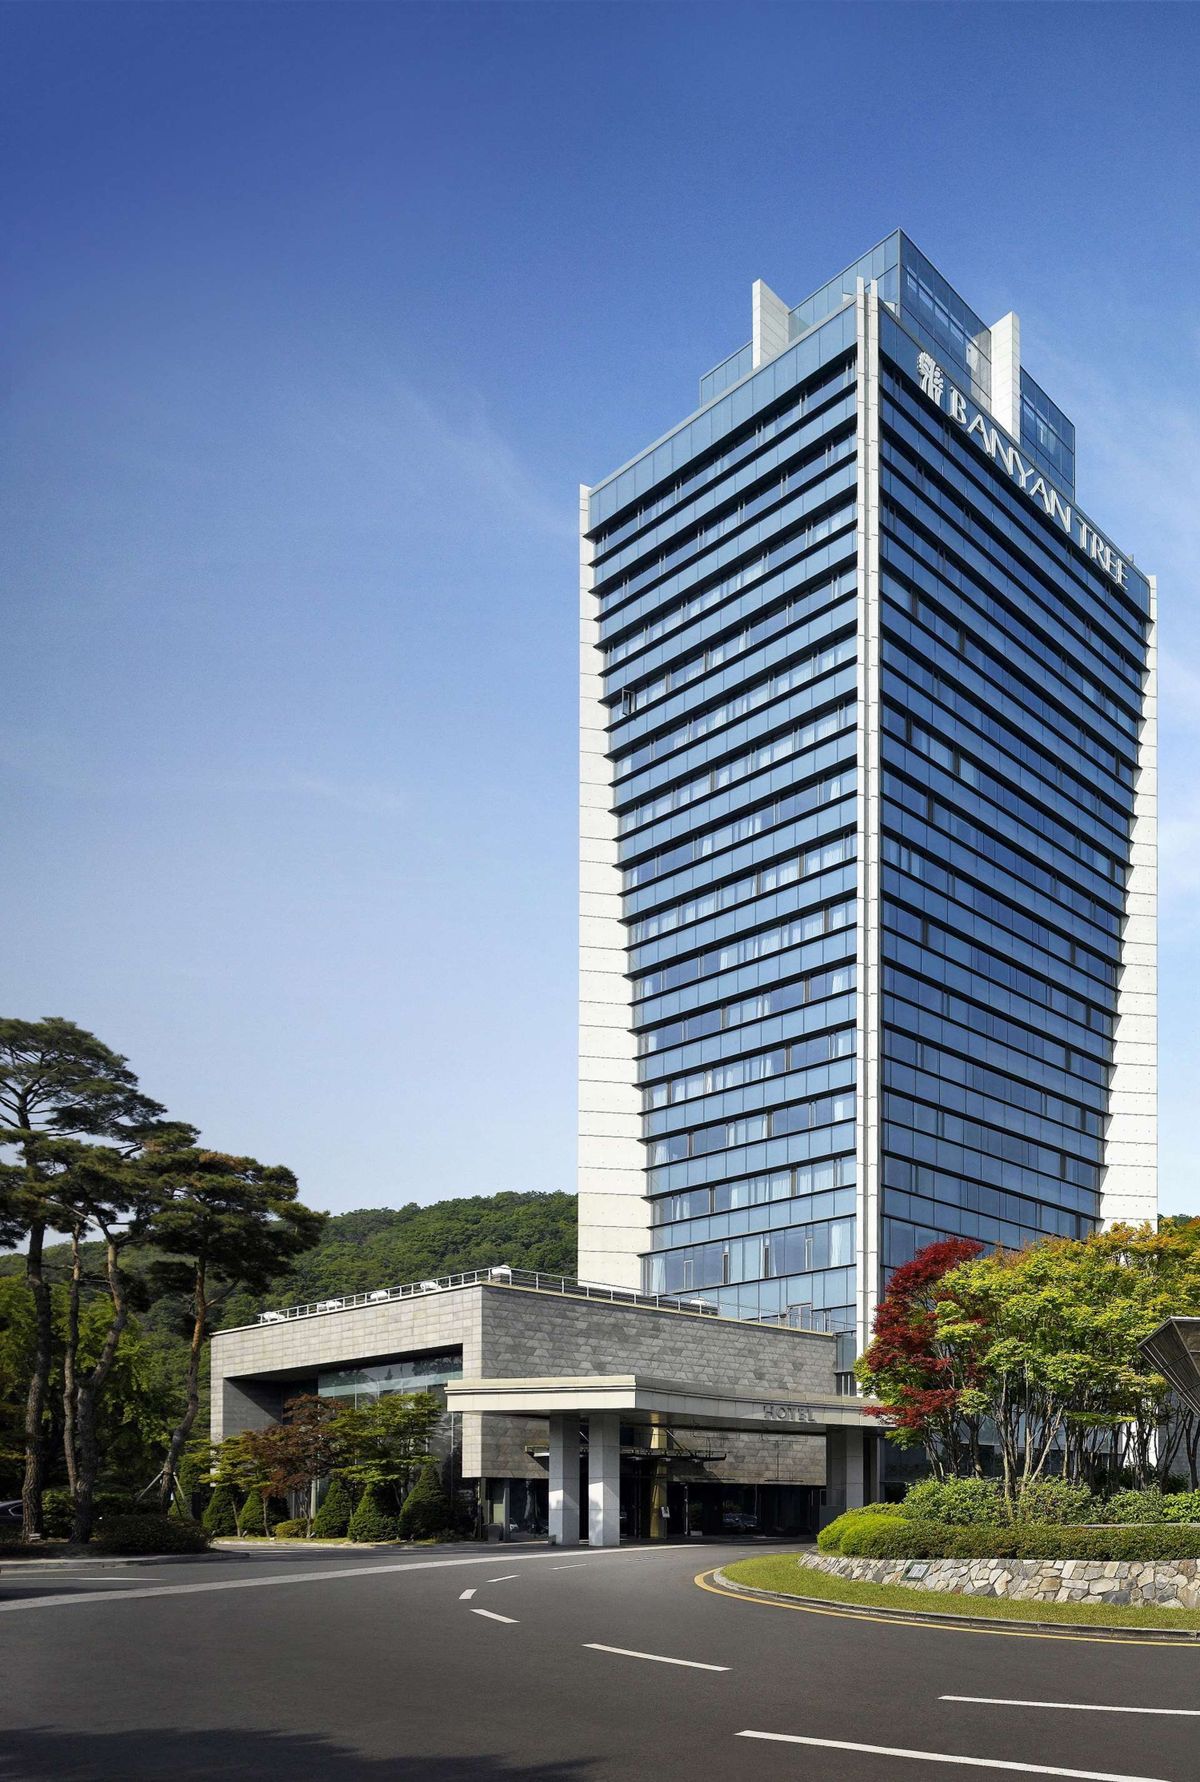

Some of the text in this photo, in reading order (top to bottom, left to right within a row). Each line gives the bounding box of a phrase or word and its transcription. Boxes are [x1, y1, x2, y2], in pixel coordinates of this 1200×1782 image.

[949, 386, 1128, 590] BANYAN TREE
[763, 1405, 816, 1422] HOTEL
